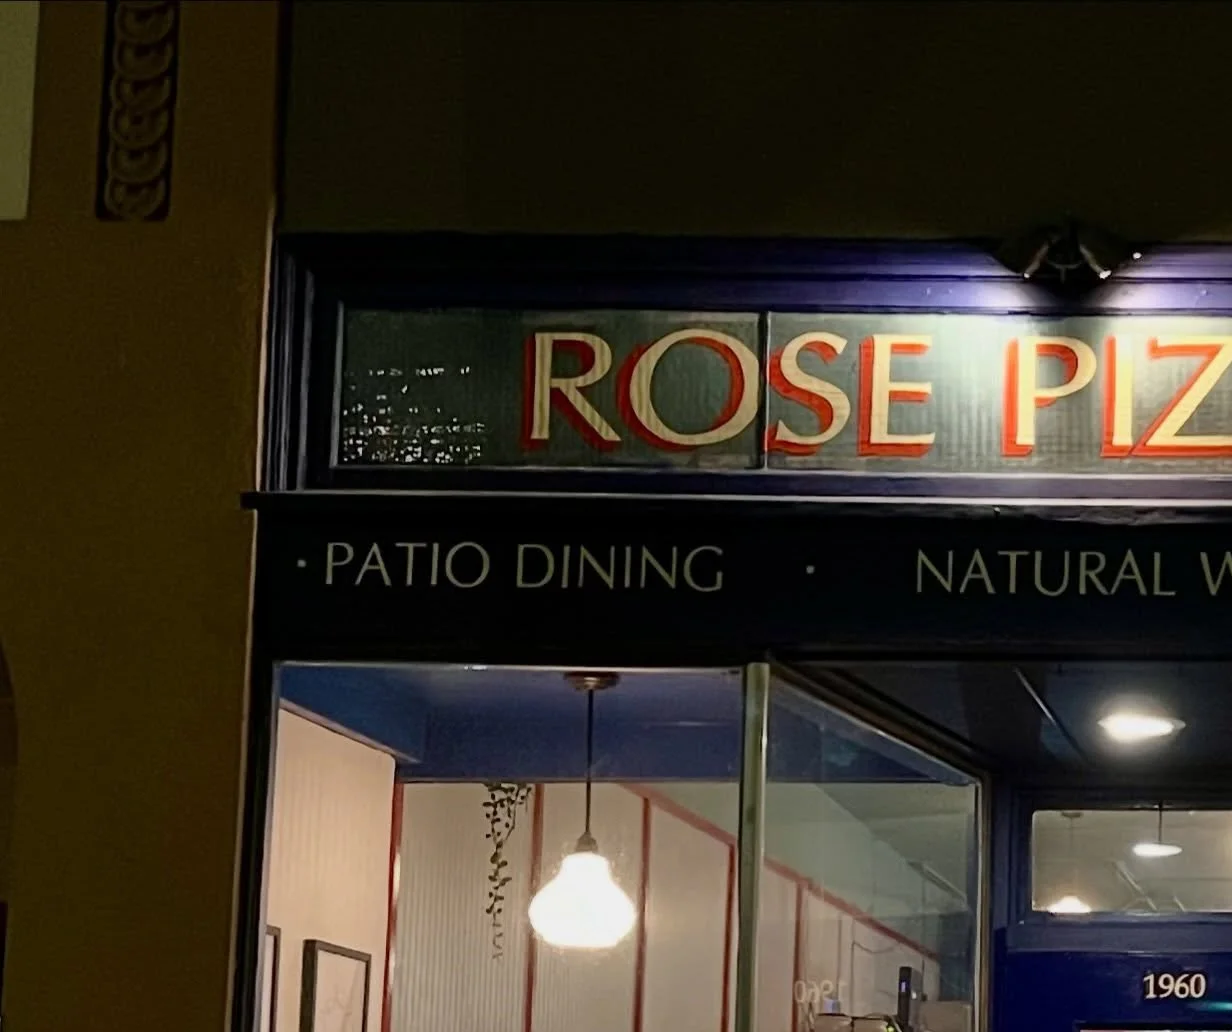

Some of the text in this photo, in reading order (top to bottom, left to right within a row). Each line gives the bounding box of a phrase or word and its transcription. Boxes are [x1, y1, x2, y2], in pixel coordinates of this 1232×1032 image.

[522, 328, 936, 458] ROSE
[324, 541, 724, 592] PATIO DINING
[916, 549, 1175, 597] NATURAL
[1143, 973, 1207, 999] 1960
